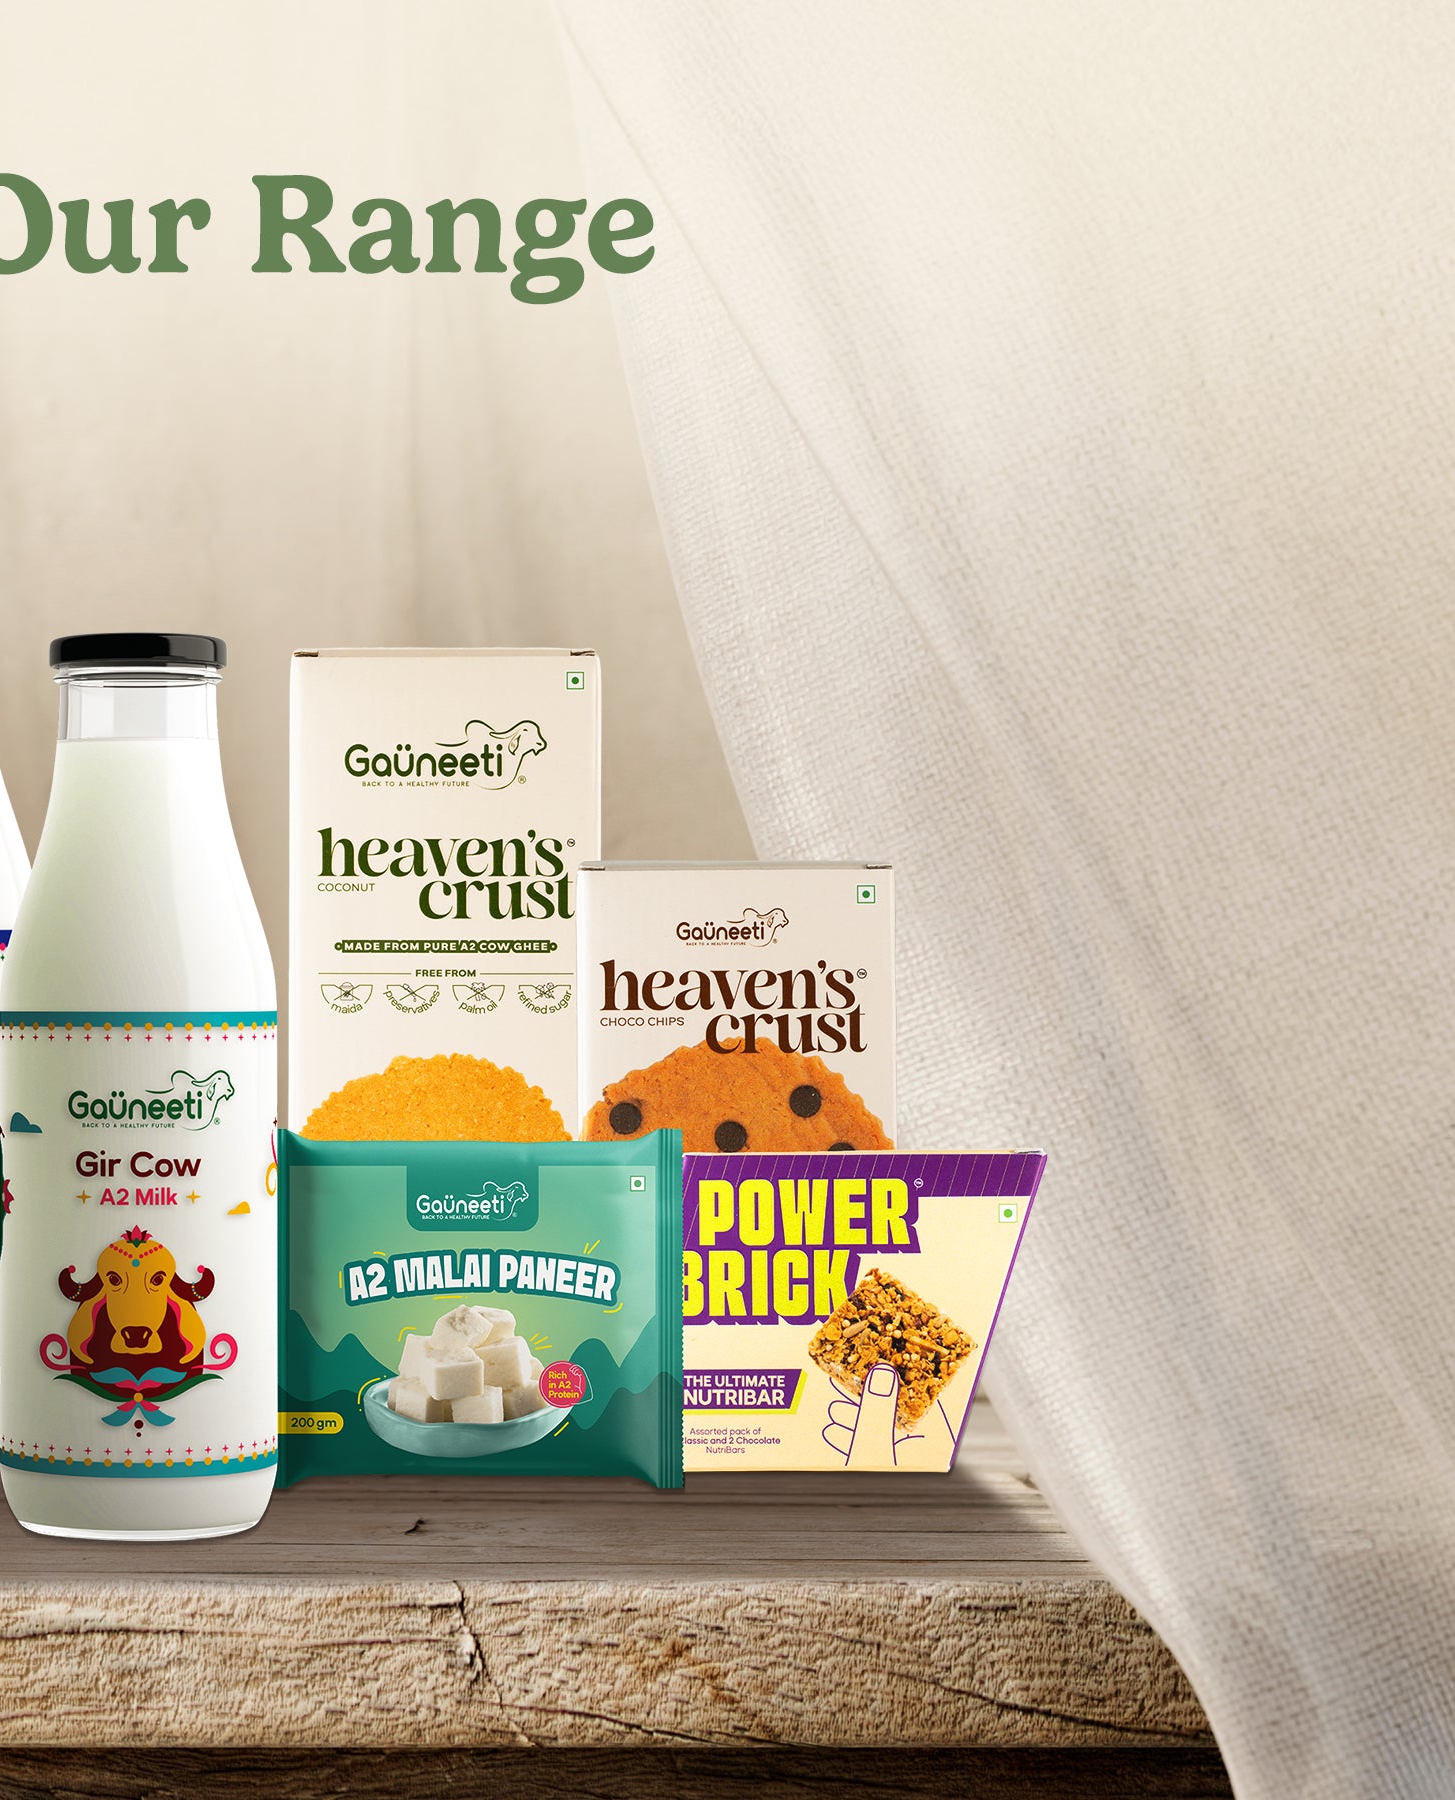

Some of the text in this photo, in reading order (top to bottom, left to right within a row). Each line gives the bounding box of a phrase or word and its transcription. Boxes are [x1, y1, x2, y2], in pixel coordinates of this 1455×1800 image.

[345, 743, 503, 777] Gaüneeti
[317, 882, 375, 893] COCONUT
[418, 873, 575, 920] crust
[676, 921, 764, 940] Gaüneeti
[344, 942, 548, 951] MADE FROM PURE A2 COW GHEE
[415, 969, 476, 977] FREE FROM
[330, 1003, 363, 1014] maida
[382, 990, 440, 1014] preservatives
[458, 1000, 498, 1014] palm oil
[517, 990, 572, 1014] refined sugar
[600, 1016, 685, 1027] CHOCO CHIPS
[705, 1003, 868, 1054] crust
[68, 1090, 202, 1120] Gaüneeti
[76, 1150, 201, 1177] Gir Cow
[99, 1187, 178, 1206] A2 Milk
[416, 1194, 504, 1214] Gaüneeti
[698, 1177, 911, 1246] POWER
[348, 1254, 616, 1301] A2 MALAI PANEER
[683, 1249, 850, 1317] BRICK
[548, 1370, 568, 1379] Rich
[683, 1375, 785, 1387] THE ULTIMATE
[548, 1380, 572, 1388] in A2
[548, 1390, 580, 1399] Protein
[683, 1389, 785, 1405] NUTRIBAR
[291, 1417, 337, 1431] 200 gm
[689, 1427, 761, 1437] Assorted pack of
[682, 1437, 781, 1445] lassic and 2 Chocolate
[705, 1446, 745, 1454] NutriBars
